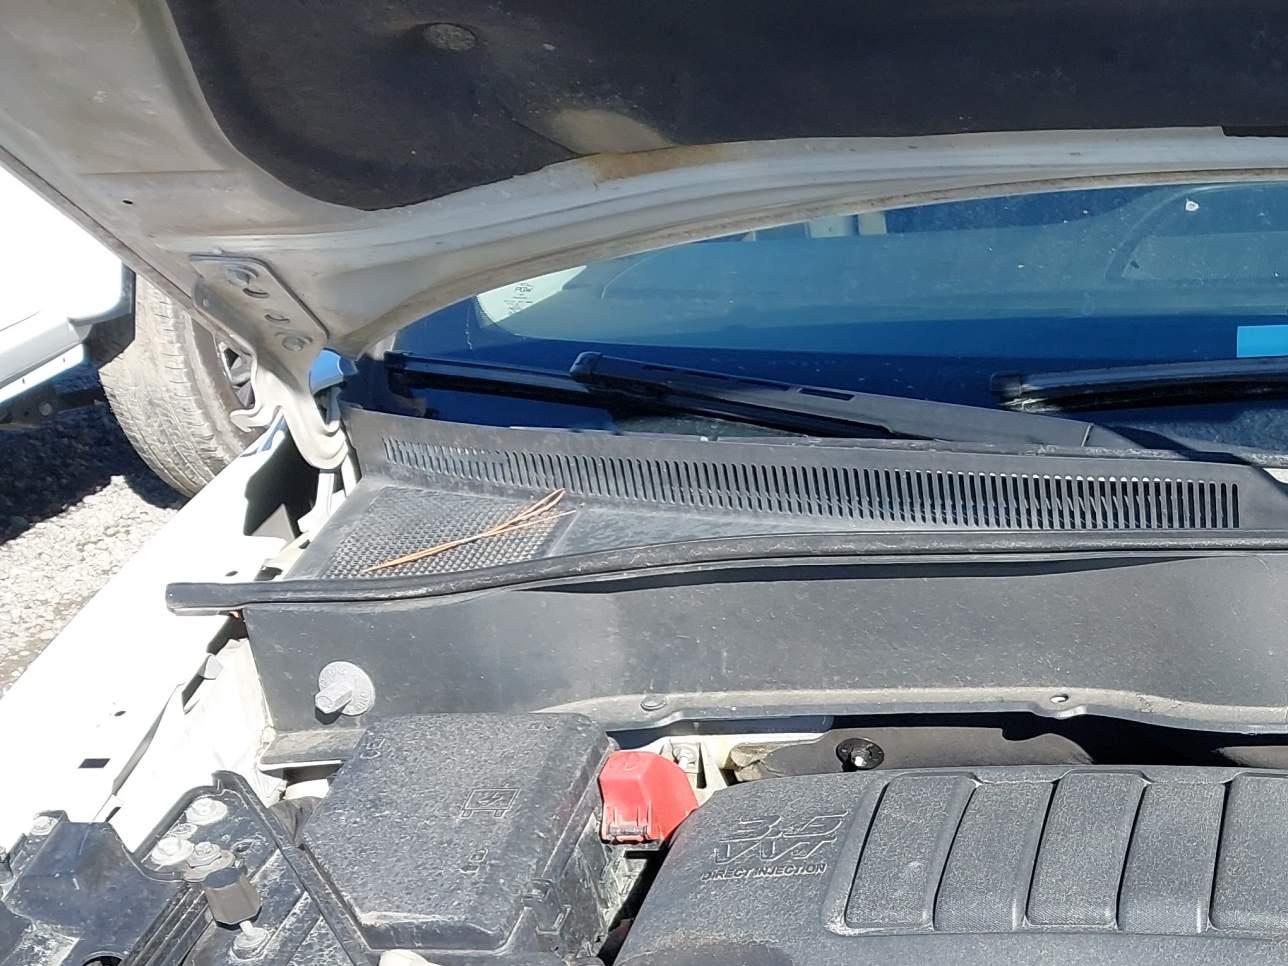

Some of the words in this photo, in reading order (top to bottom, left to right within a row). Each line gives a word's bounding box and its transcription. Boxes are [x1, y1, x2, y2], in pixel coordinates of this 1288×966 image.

[713, 838, 837, 864] VVT
[701, 867, 753, 881] DIRECT
[753, 862, 827, 878] INJECTION
